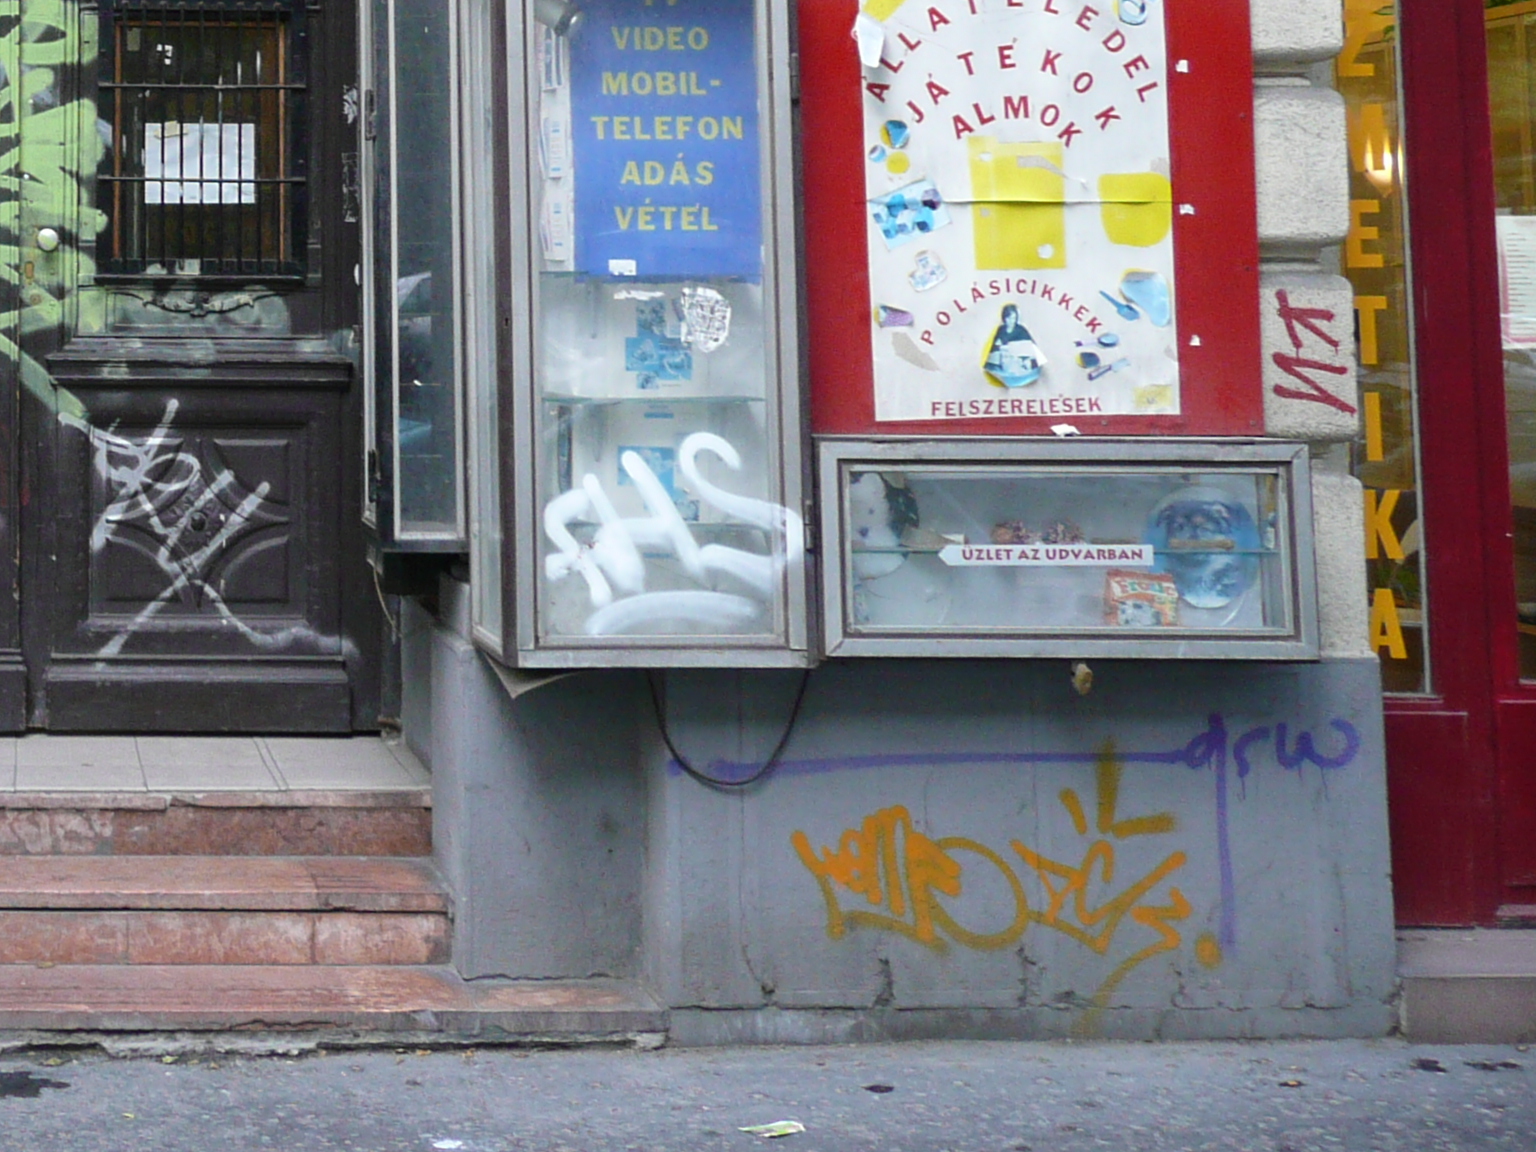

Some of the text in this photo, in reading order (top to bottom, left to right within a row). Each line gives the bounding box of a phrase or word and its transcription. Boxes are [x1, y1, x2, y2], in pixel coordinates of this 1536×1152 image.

[611, 26, 709, 50] VIDEO
[602, 72, 722, 96] MOBIL-
[910, 37, 1121, 131] JÁTÉKOK
[590, 115, 744, 141] TELEFON
[951, 94, 1083, 149] ALMOK
[619, 152, 715, 186] ADÁS
[961, 544, 1144, 562] ÜZLET AZ UDVARBAN
